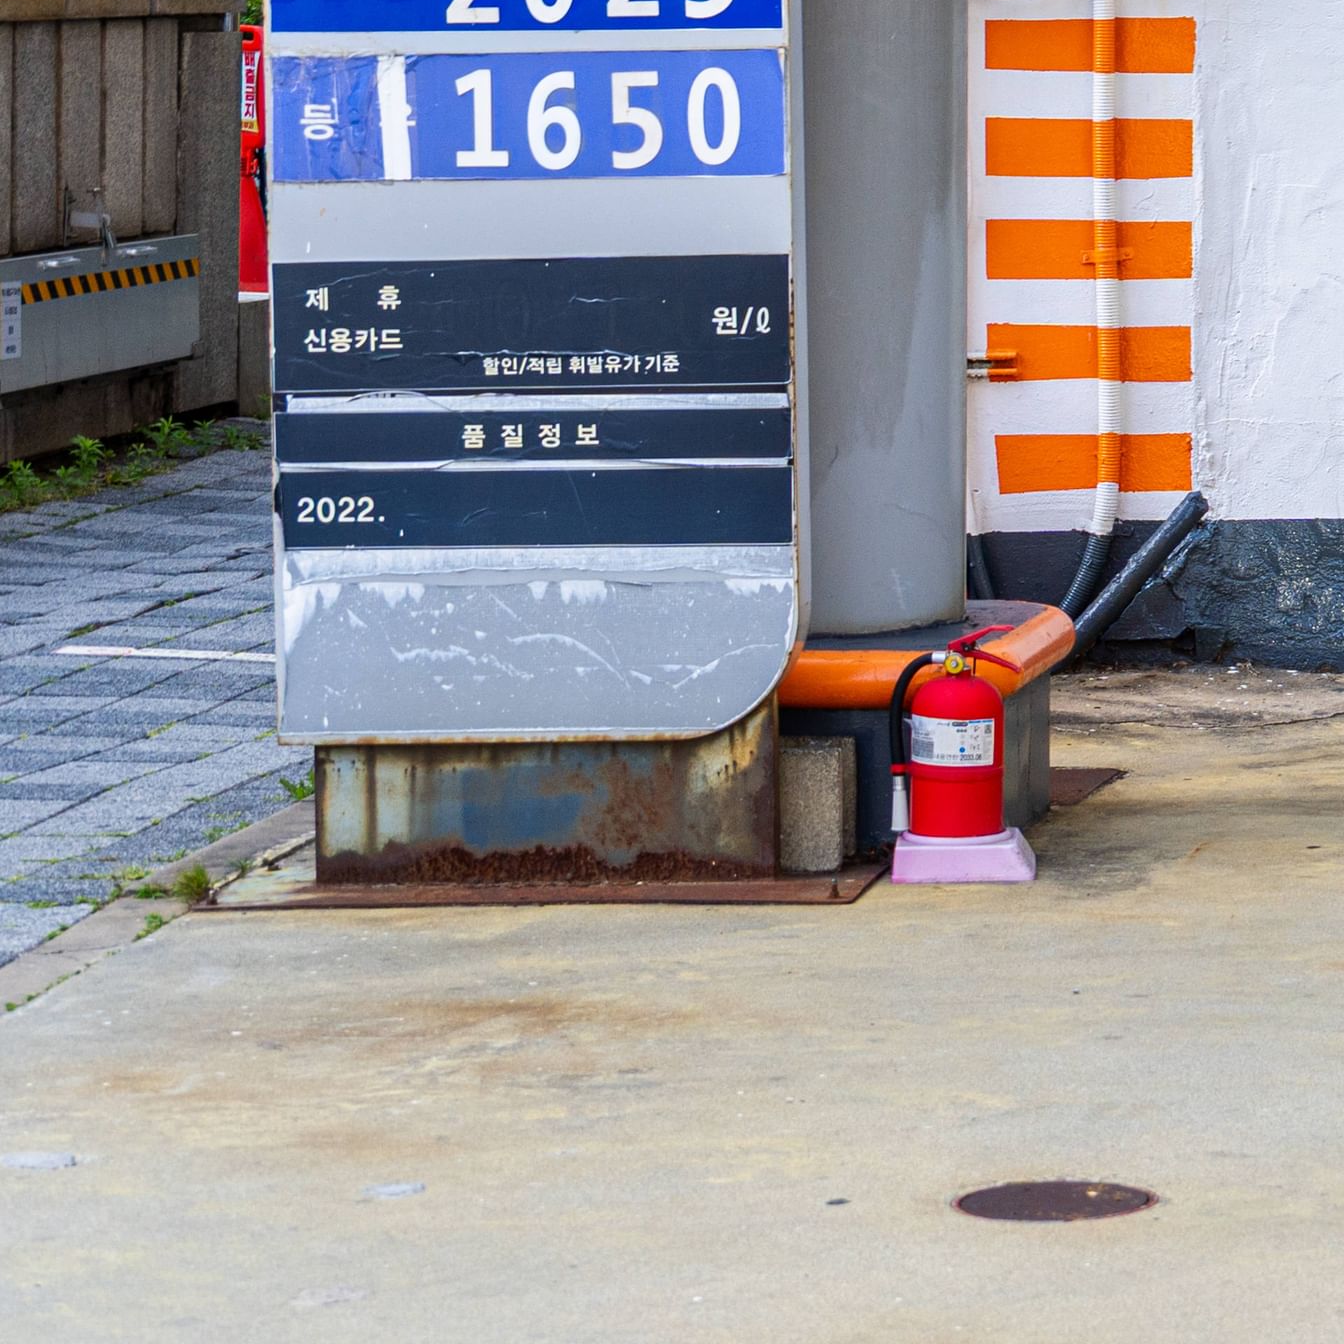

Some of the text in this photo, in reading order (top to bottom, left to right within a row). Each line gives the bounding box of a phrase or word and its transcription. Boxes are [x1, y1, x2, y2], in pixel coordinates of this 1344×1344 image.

[454, 67, 742, 172] 1650
[304, 326, 404, 353] 신용카드
[482, 355, 563, 377] 할인/적립
[643, 353, 680, 374] 기준
[296, 496, 387, 524] 2022.
